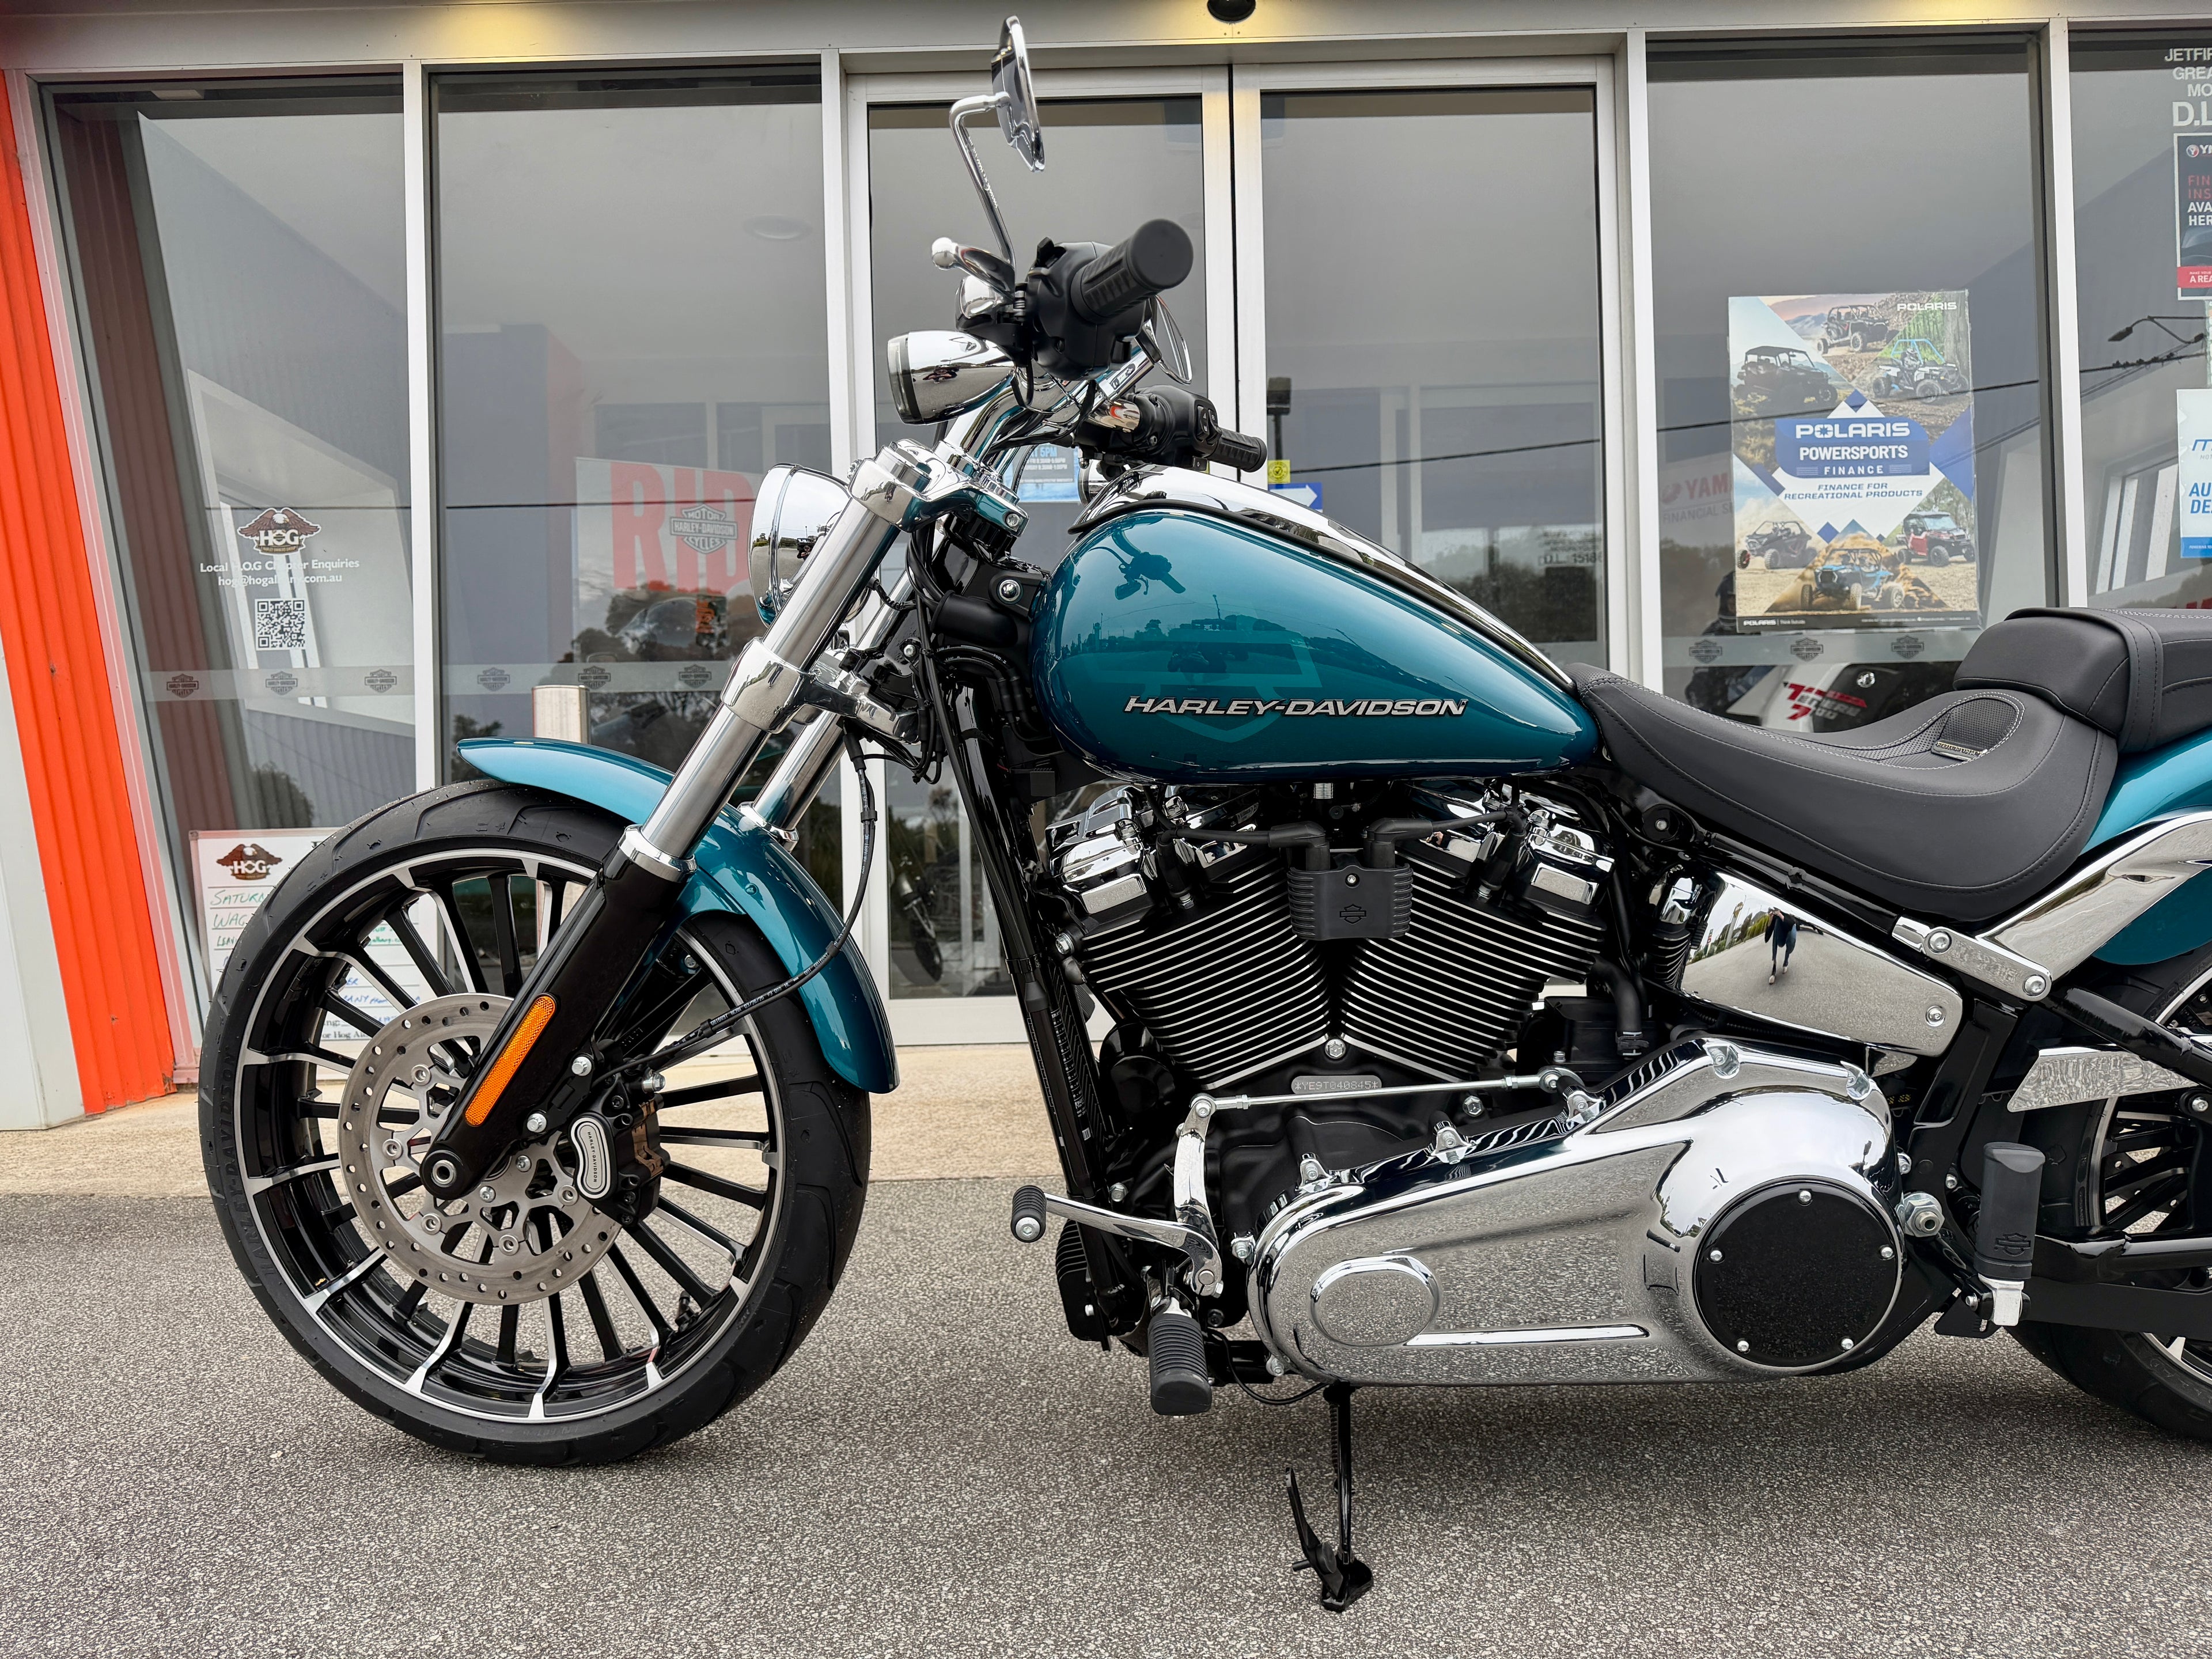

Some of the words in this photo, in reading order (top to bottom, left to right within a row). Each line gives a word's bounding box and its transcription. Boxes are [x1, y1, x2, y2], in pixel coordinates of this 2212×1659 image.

[1897, 301, 1957, 311] POLARIS
[1796, 422, 1910, 438] POLARIS
[1799, 445, 1908, 461] POWERSPORTS
[1824, 465, 1884, 476] FINANCE
[1818, 483, 1864, 491] FINANCE
[1784, 491, 1863, 501] RECREATIONAL
[1865, 490, 1923, 498] PRODUCTS
[2190, 499, 2212, 514] DE
[259, 529, 299, 546] HOG
[200, 562, 228, 573] Local
[311, 558, 361, 571] Enquiries
[1124, 695, 1468, 717] HARLEY-DAVIDSON
[233, 859, 267, 874] HOG
[587, 1131, 598, 1183] HARLEY-DAVIDSON
